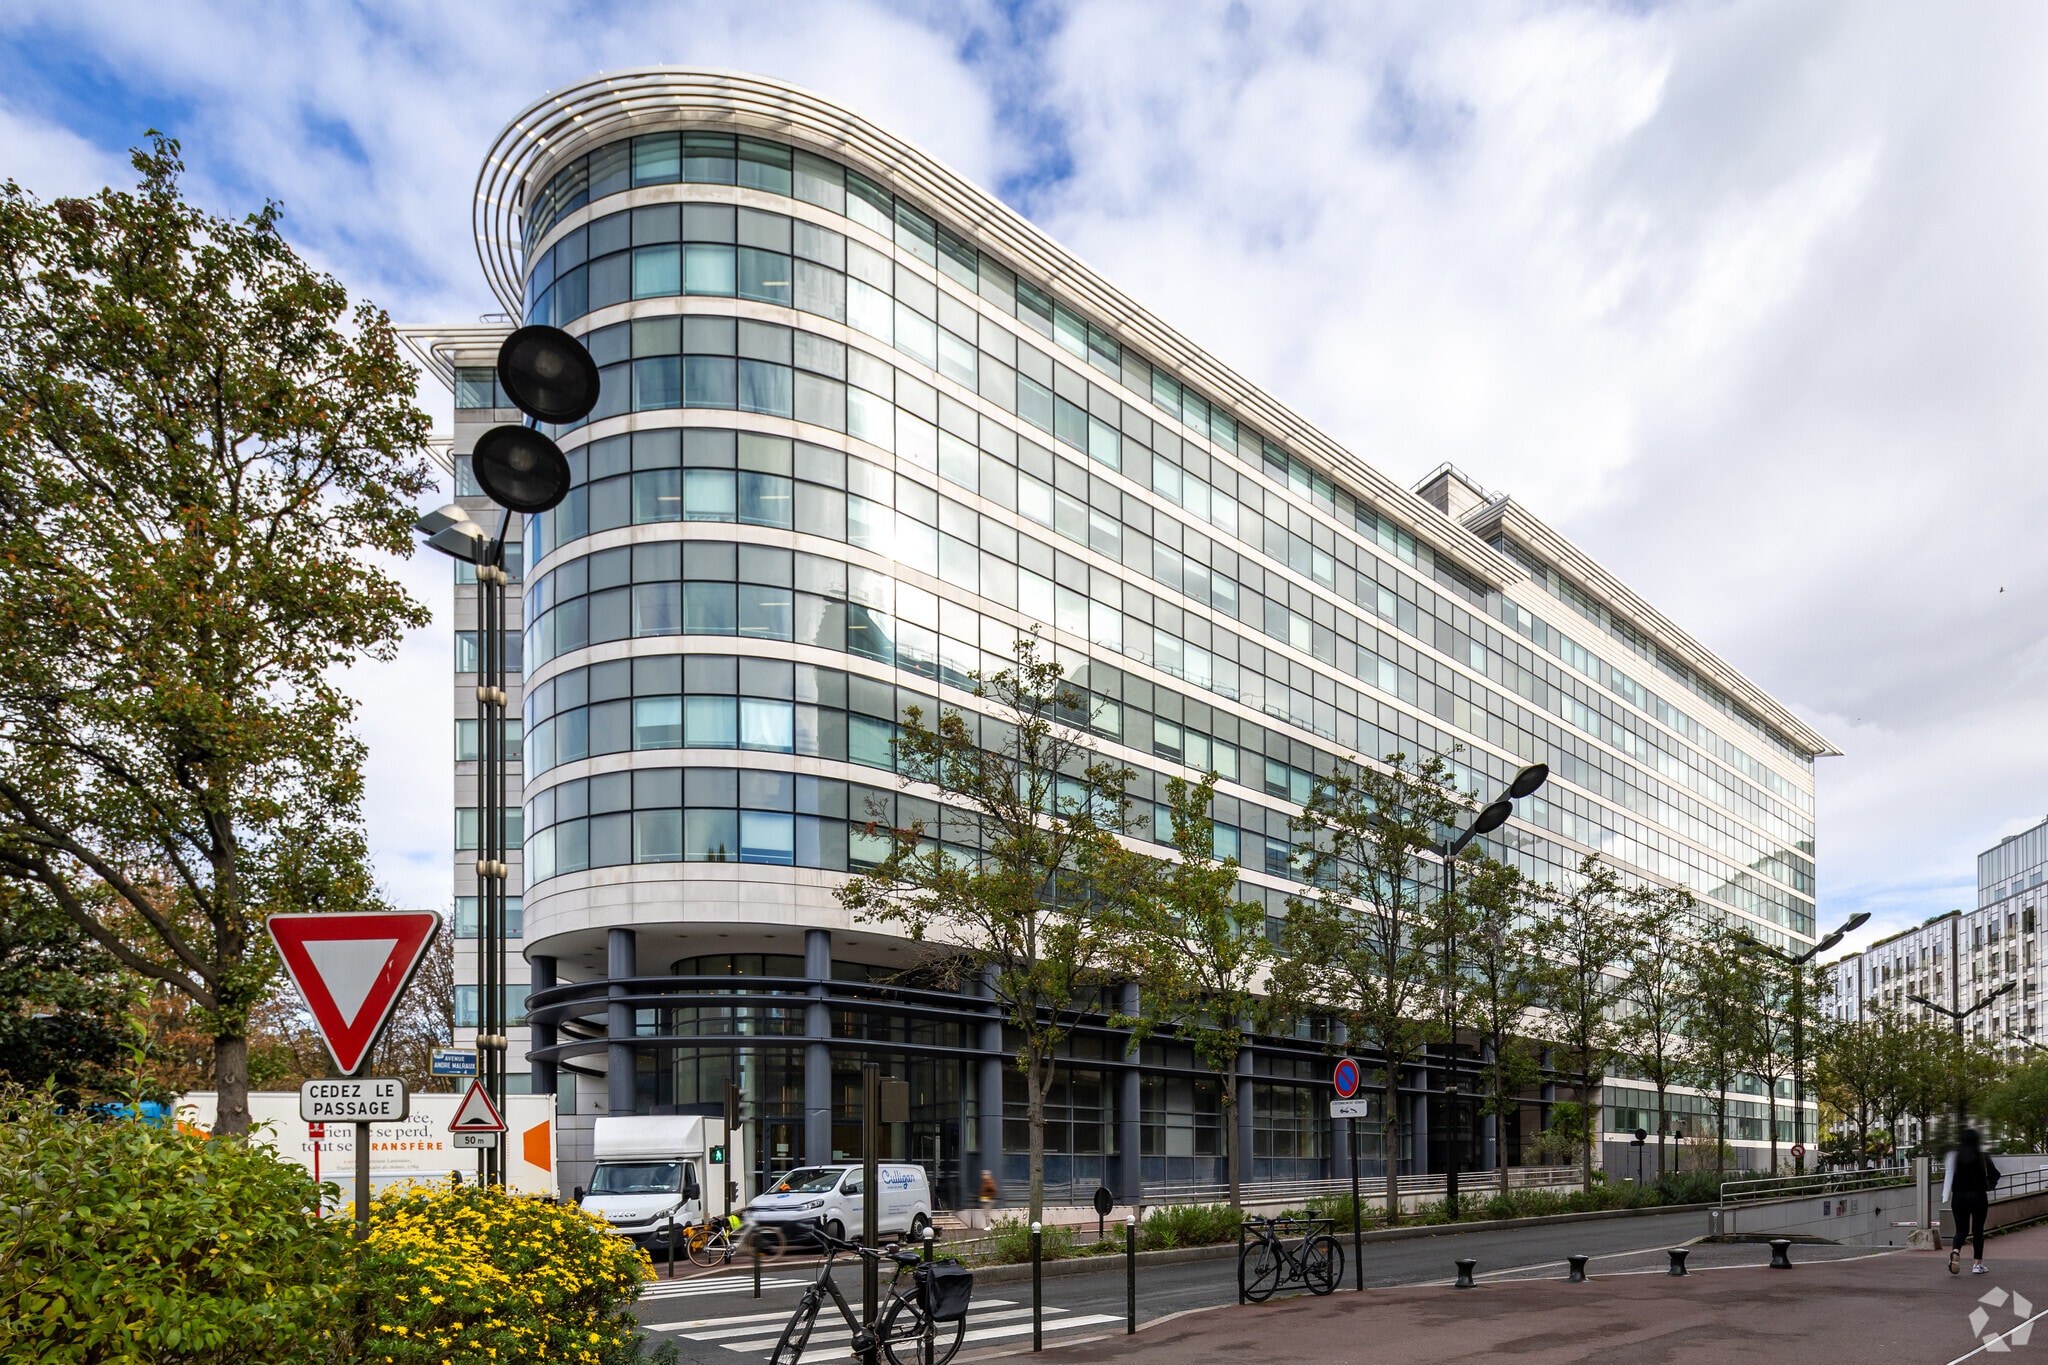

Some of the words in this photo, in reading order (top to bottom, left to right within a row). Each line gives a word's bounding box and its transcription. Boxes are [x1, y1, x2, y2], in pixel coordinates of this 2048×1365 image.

[376, 1084, 395, 1098] LE
[314, 1101, 390, 1116] PASSAGE
[402, 1111, 433, 1125] rée,
[376, 1128, 391, 1138] se
[395, 1125, 433, 1140] perd,
[337, 1142, 353, 1152] se
[371, 1140, 443, 1151] RANSFÈRE
[464, 1136, 476, 1144] 50
[881, 1169, 915, 1190] Culligan
[608, 1210, 637, 1218] IVECO
